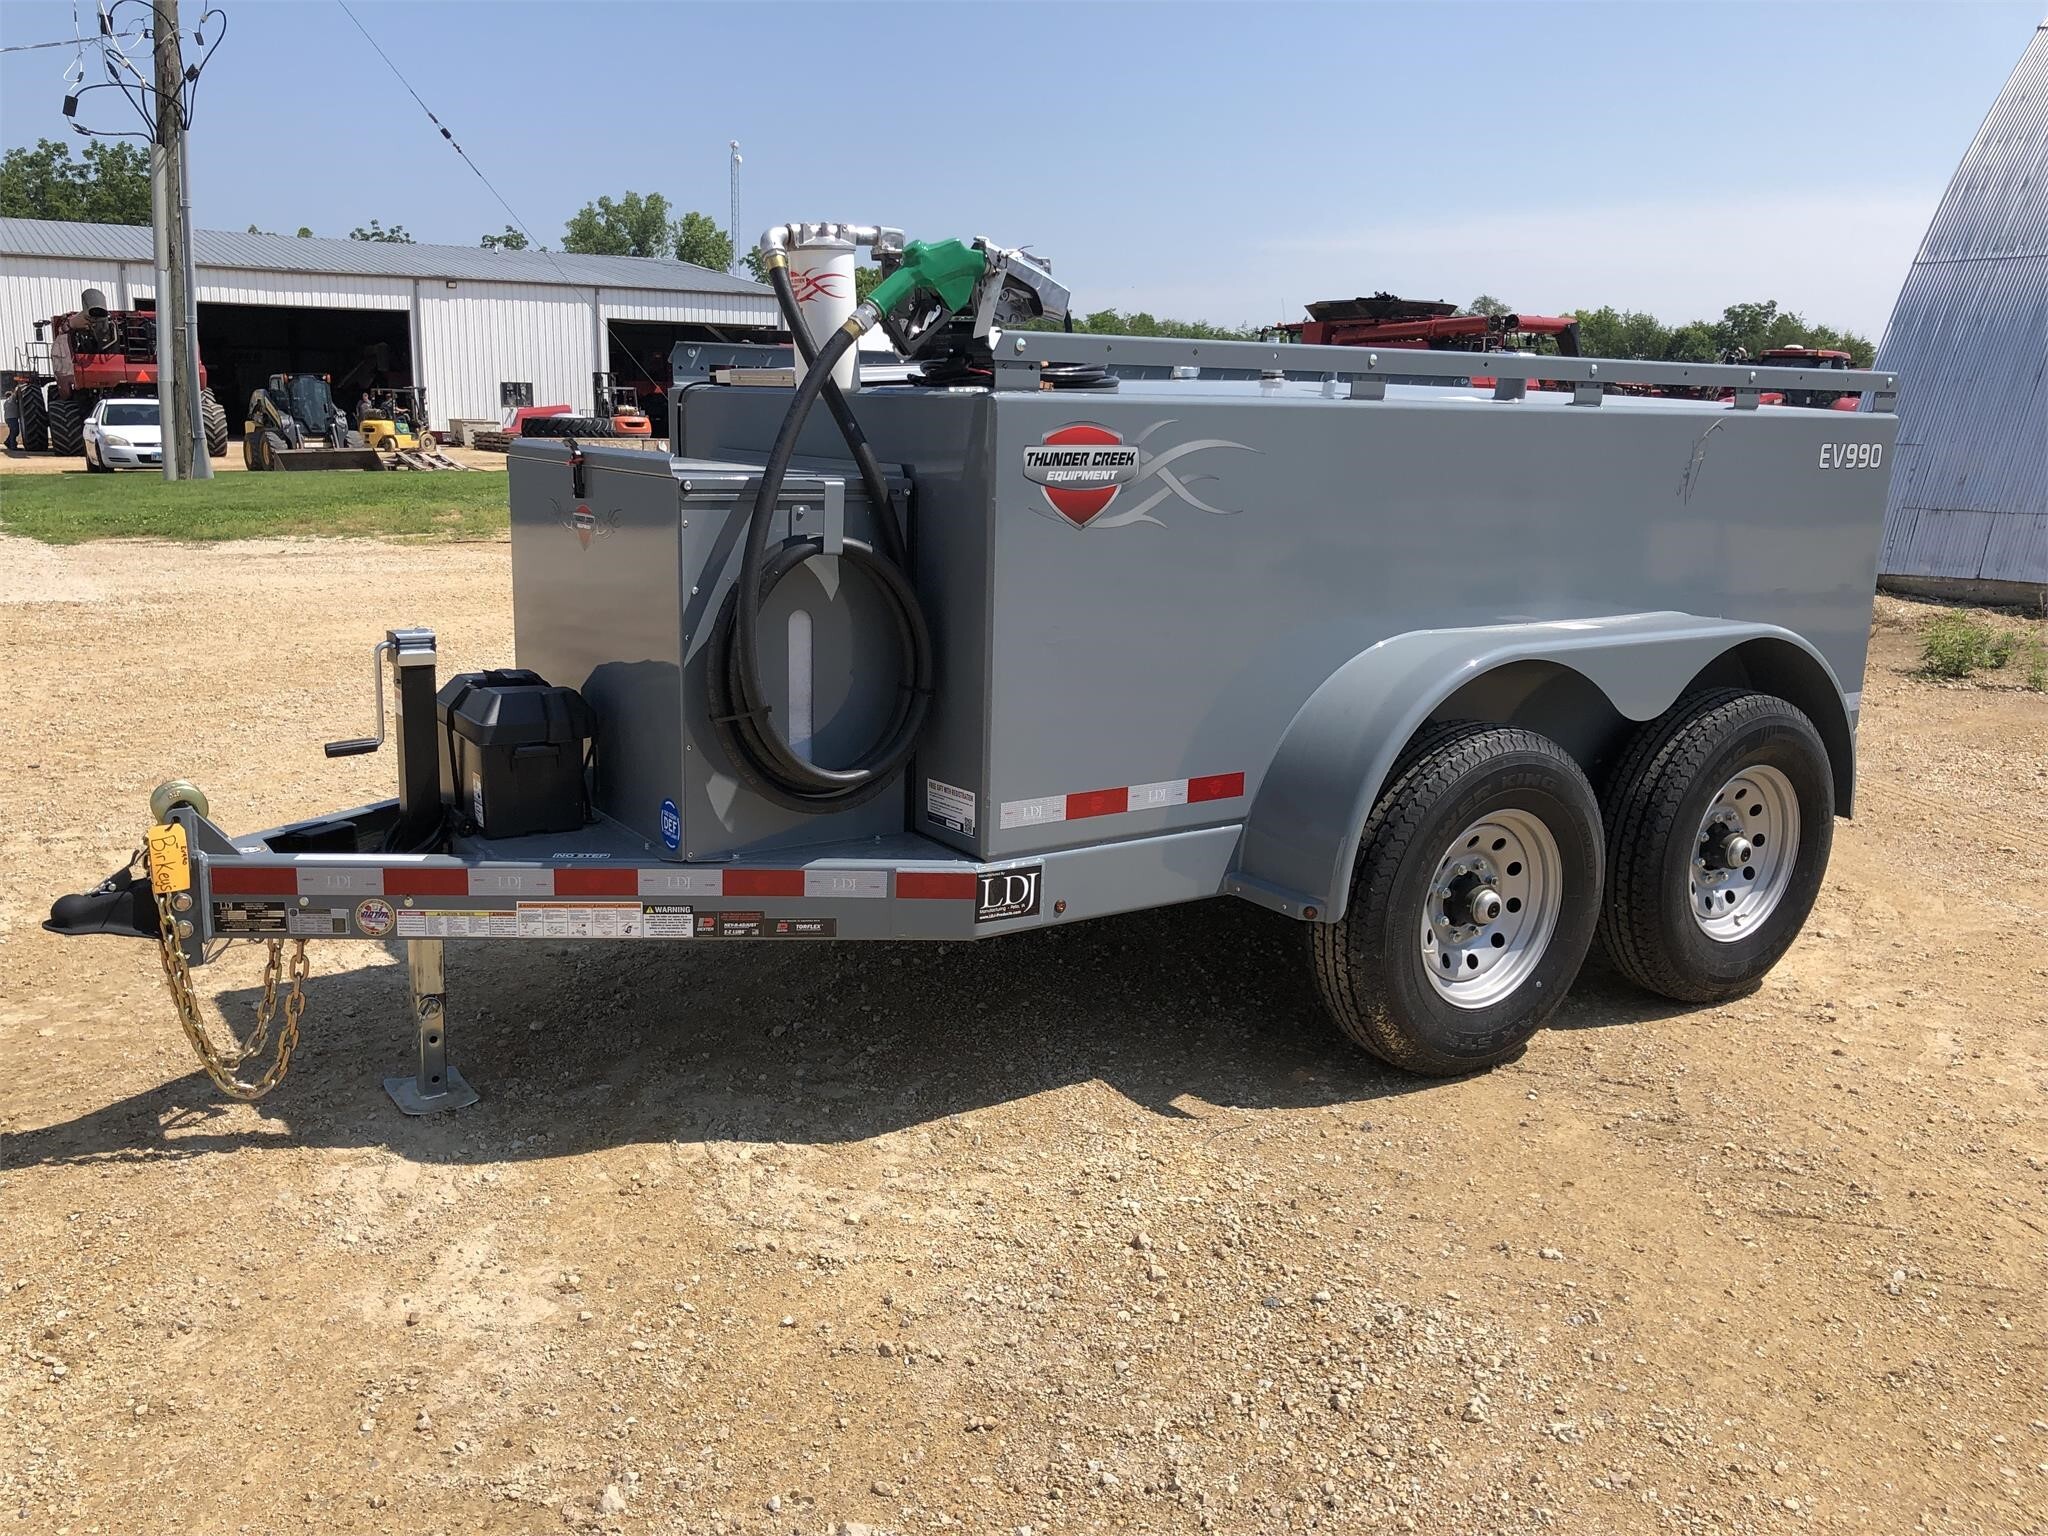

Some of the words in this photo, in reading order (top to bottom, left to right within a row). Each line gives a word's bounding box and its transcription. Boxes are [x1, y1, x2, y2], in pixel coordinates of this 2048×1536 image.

[1026, 451, 1088, 467] THUNDER
[1091, 451, 1136, 466] CREEK
[1819, 443, 1883, 469] EV990
[1046, 470, 1118, 482] EQUIPMENT
[663, 815, 678, 834] DEF
[980, 872, 1040, 913] LDJ
[654, 906, 691, 914] WARNING
